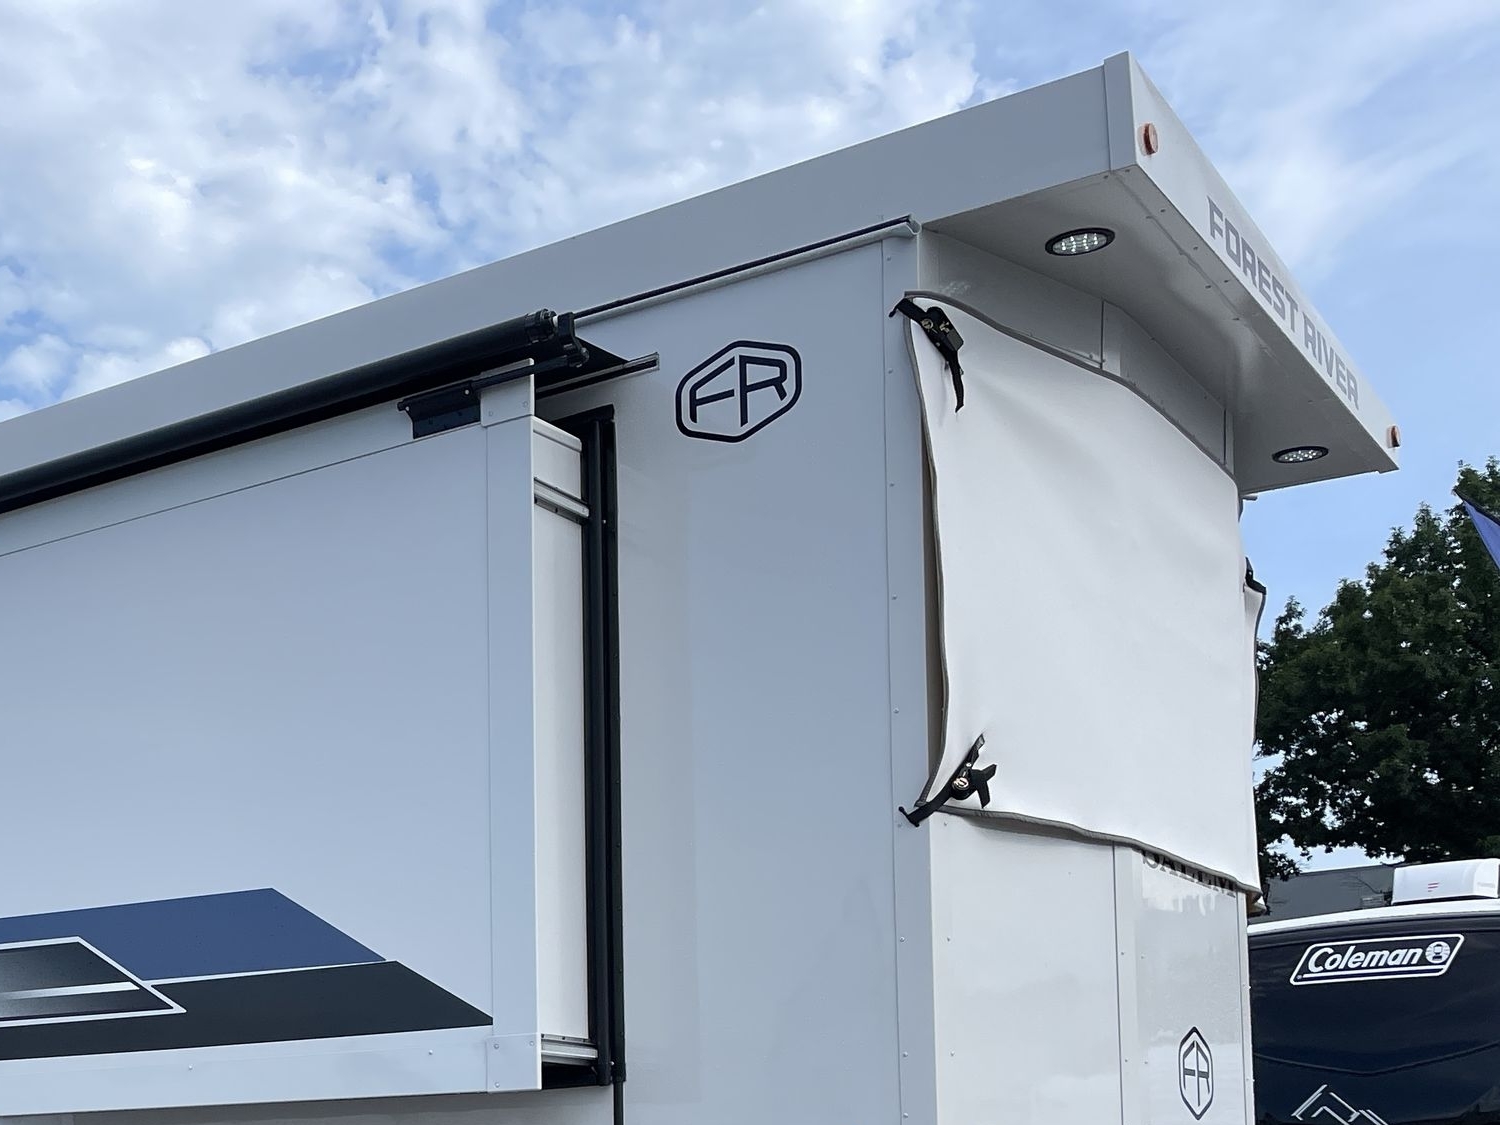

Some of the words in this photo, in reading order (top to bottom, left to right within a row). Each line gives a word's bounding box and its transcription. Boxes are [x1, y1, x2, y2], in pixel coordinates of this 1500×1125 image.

[1207, 196, 1299, 333] FOREST
[1303, 311, 1359, 411] RIVER
[1307, 945, 1424, 973] Coleman
